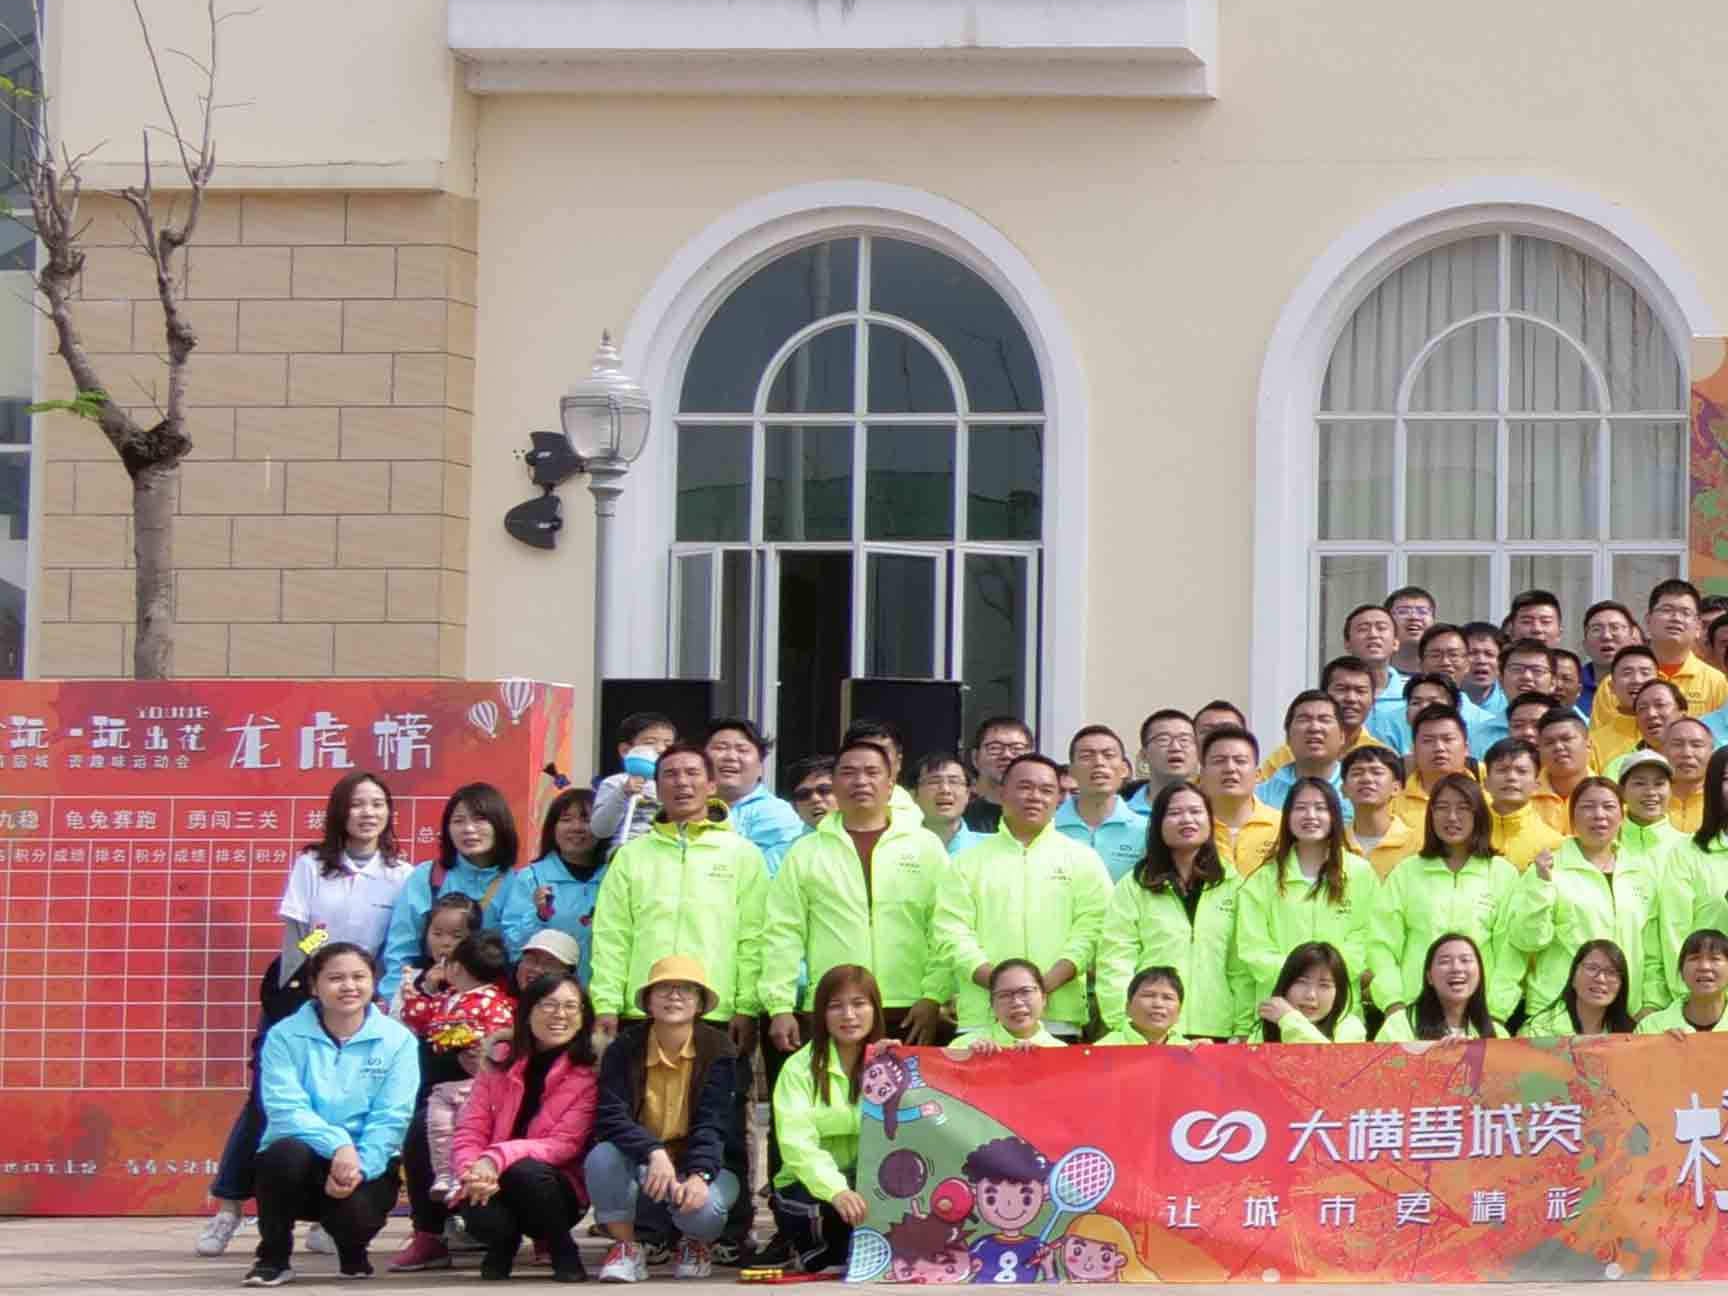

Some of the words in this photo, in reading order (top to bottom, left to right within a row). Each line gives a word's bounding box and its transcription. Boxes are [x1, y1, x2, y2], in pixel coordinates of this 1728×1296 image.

[225, 711, 433, 771] 龙虎榜
[65, 809, 158, 830] 龟兔赛跑
[185, 809, 279, 830] 勇闯三关
[1288, 1102, 1583, 1163] 大横琴城资
[1166, 1186, 1583, 1230] 让城市更精彩
[993, 1251, 1019, 1282] 8
